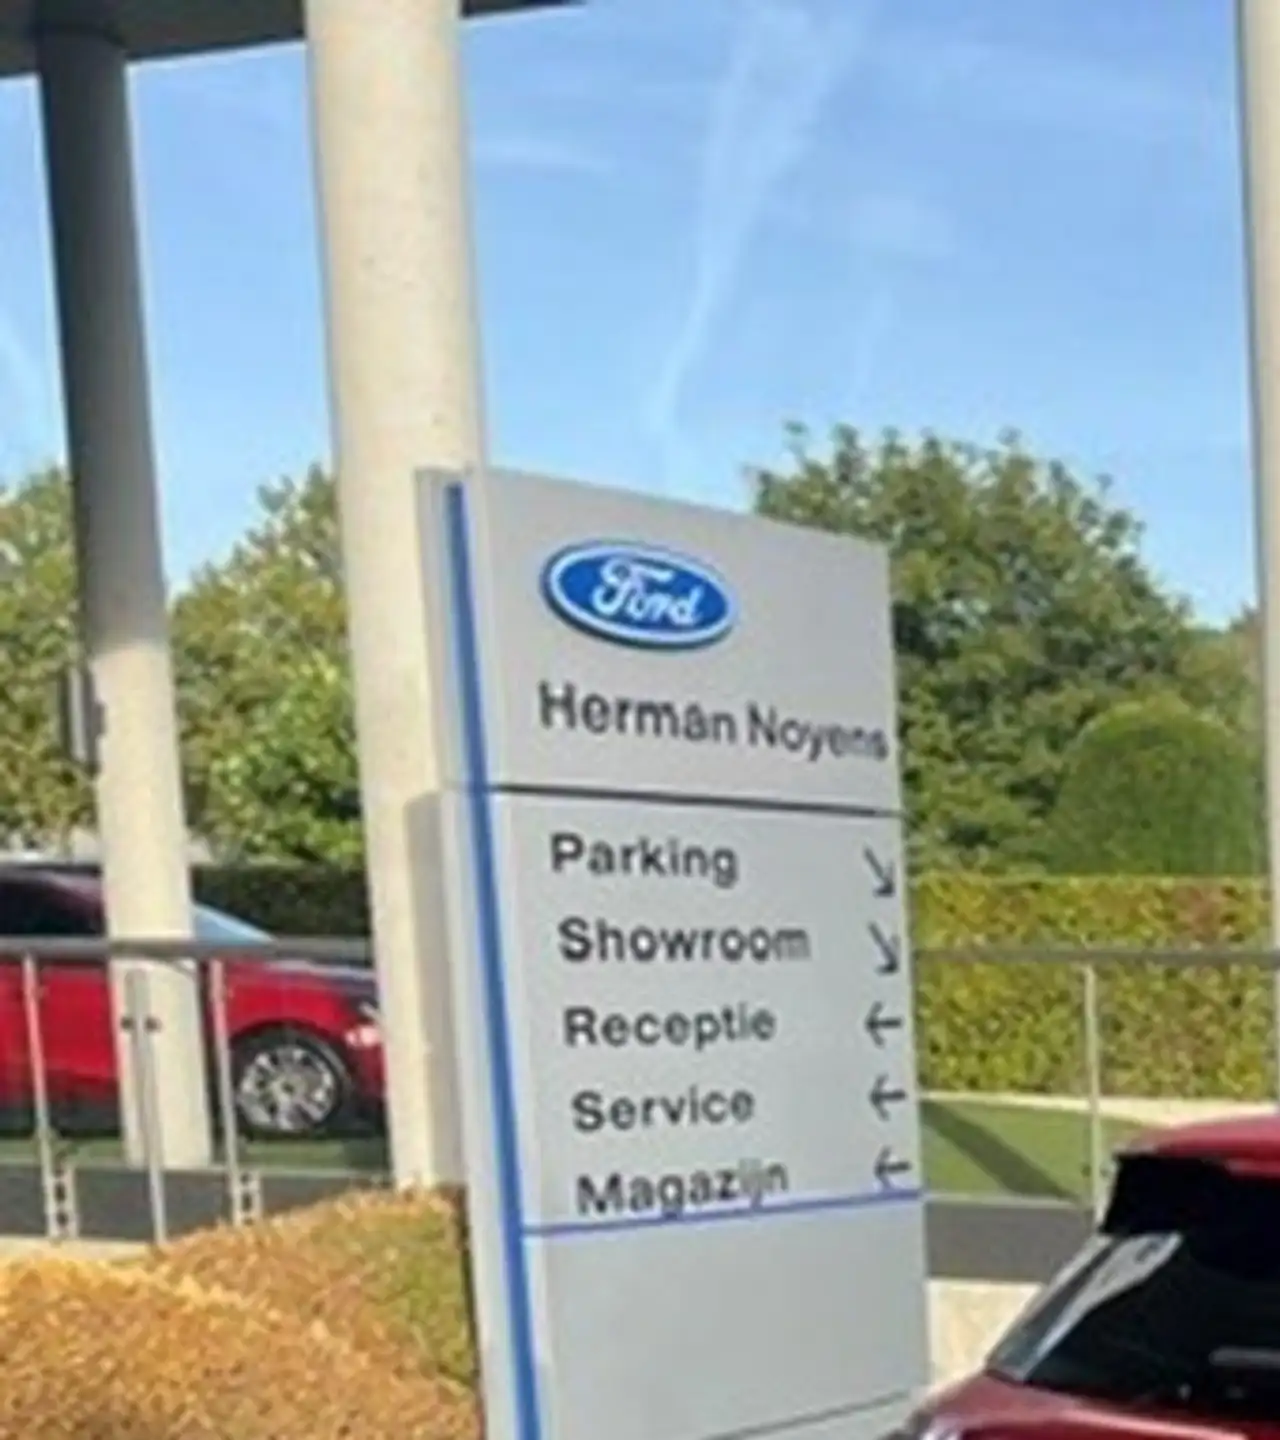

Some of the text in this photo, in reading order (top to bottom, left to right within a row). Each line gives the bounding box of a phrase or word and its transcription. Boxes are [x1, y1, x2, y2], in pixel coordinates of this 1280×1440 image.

[592, 555, 702, 627] Ford
[538, 680, 890, 763] Herman Noyens
[550, 831, 740, 889] Parking
[557, 915, 812, 964] Showroom
[563, 1003, 778, 1051] Receptie
[571, 1086, 757, 1134] Service
[577, 1157, 790, 1219] Magazijn
